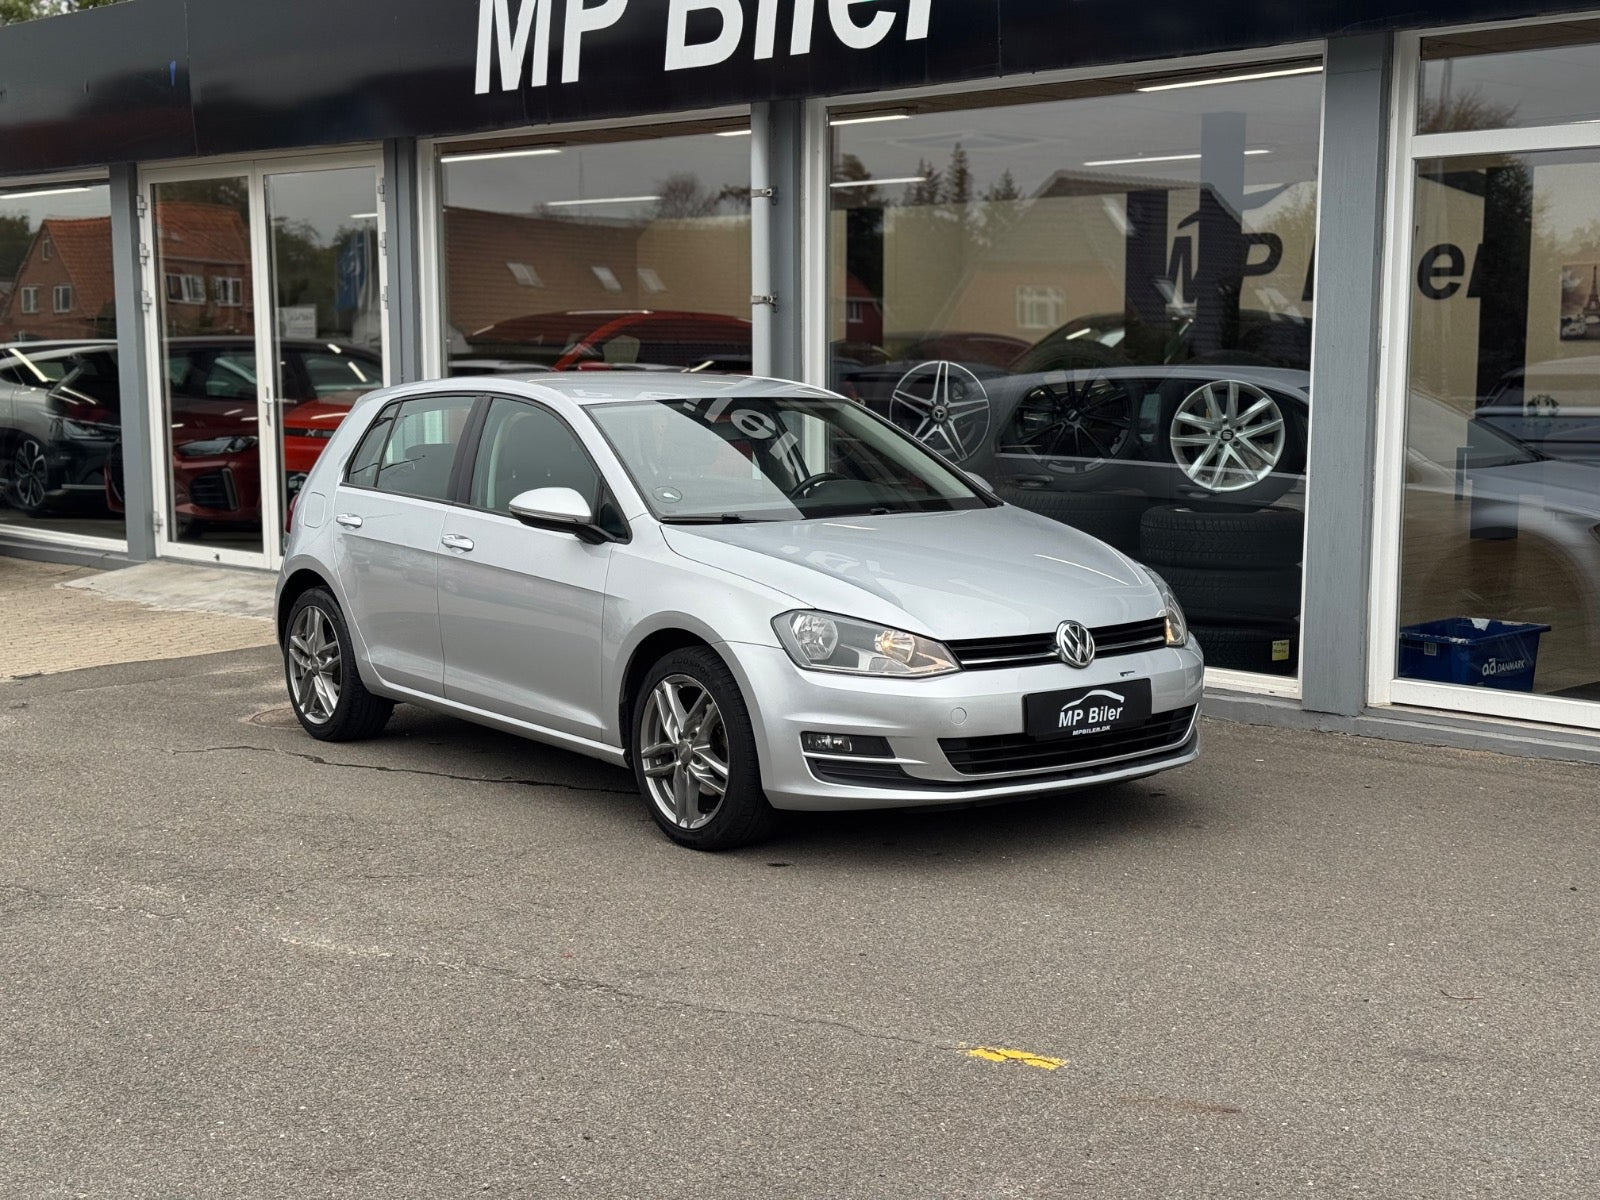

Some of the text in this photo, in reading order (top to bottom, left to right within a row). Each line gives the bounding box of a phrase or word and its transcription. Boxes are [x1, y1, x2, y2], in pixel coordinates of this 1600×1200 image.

[475, 0, 628, 94] MP
[1058, 705, 1123, 727] MP Biler
